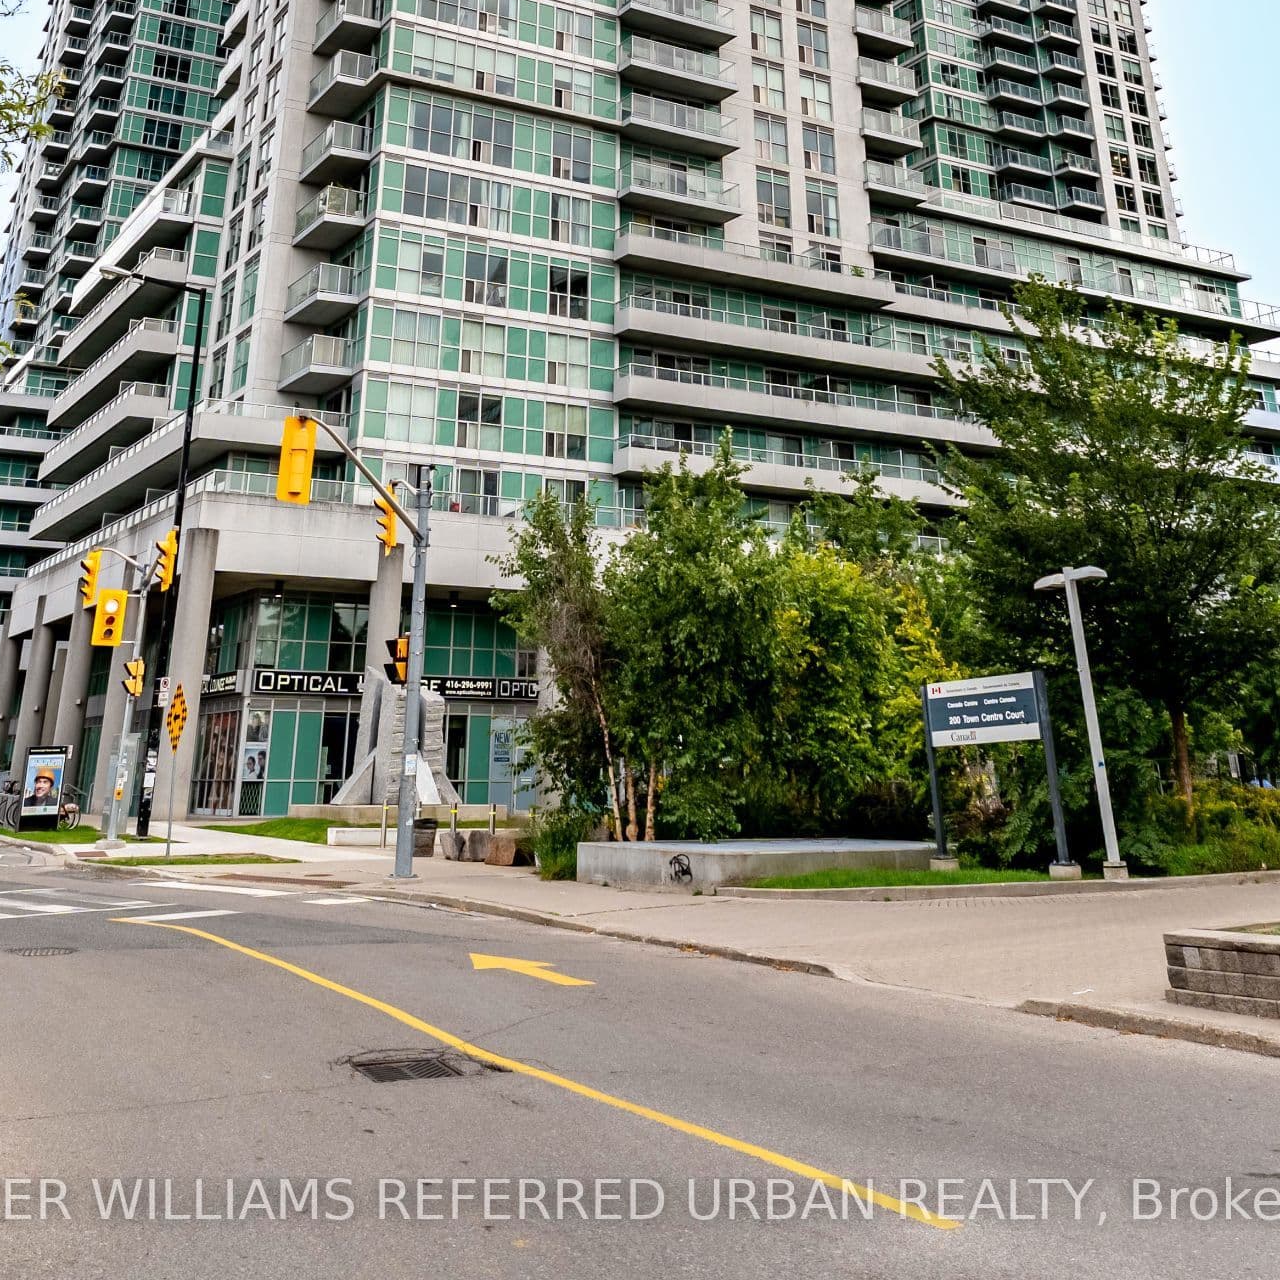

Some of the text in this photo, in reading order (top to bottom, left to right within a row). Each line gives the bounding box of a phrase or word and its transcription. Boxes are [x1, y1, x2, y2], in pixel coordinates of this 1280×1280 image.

[259, 672, 348, 692] OPTICAL
[445, 681, 493, 689] 416-296-9991
[949, 710, 1024, 724] 200 Town Centre Court
[950, 731, 976, 742] Canada
